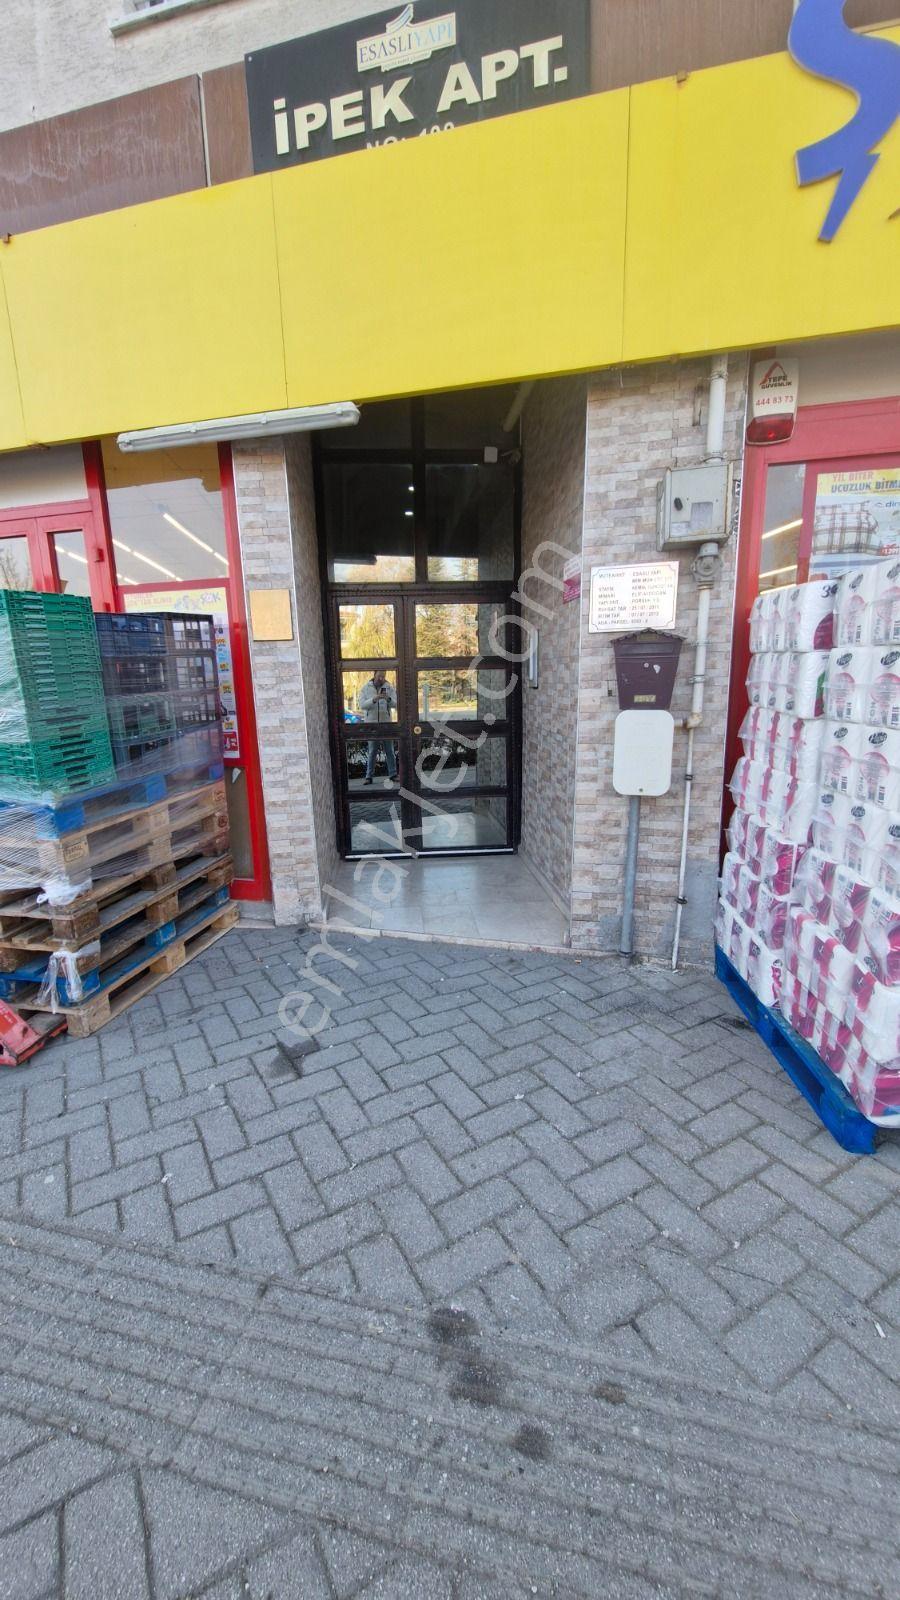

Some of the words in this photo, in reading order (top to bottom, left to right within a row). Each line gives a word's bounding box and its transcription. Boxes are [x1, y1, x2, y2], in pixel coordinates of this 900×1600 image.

[436, 34, 568, 113] APT.
[768, 375, 787, 383] TEPE
[756, 397, 770, 406] 444
